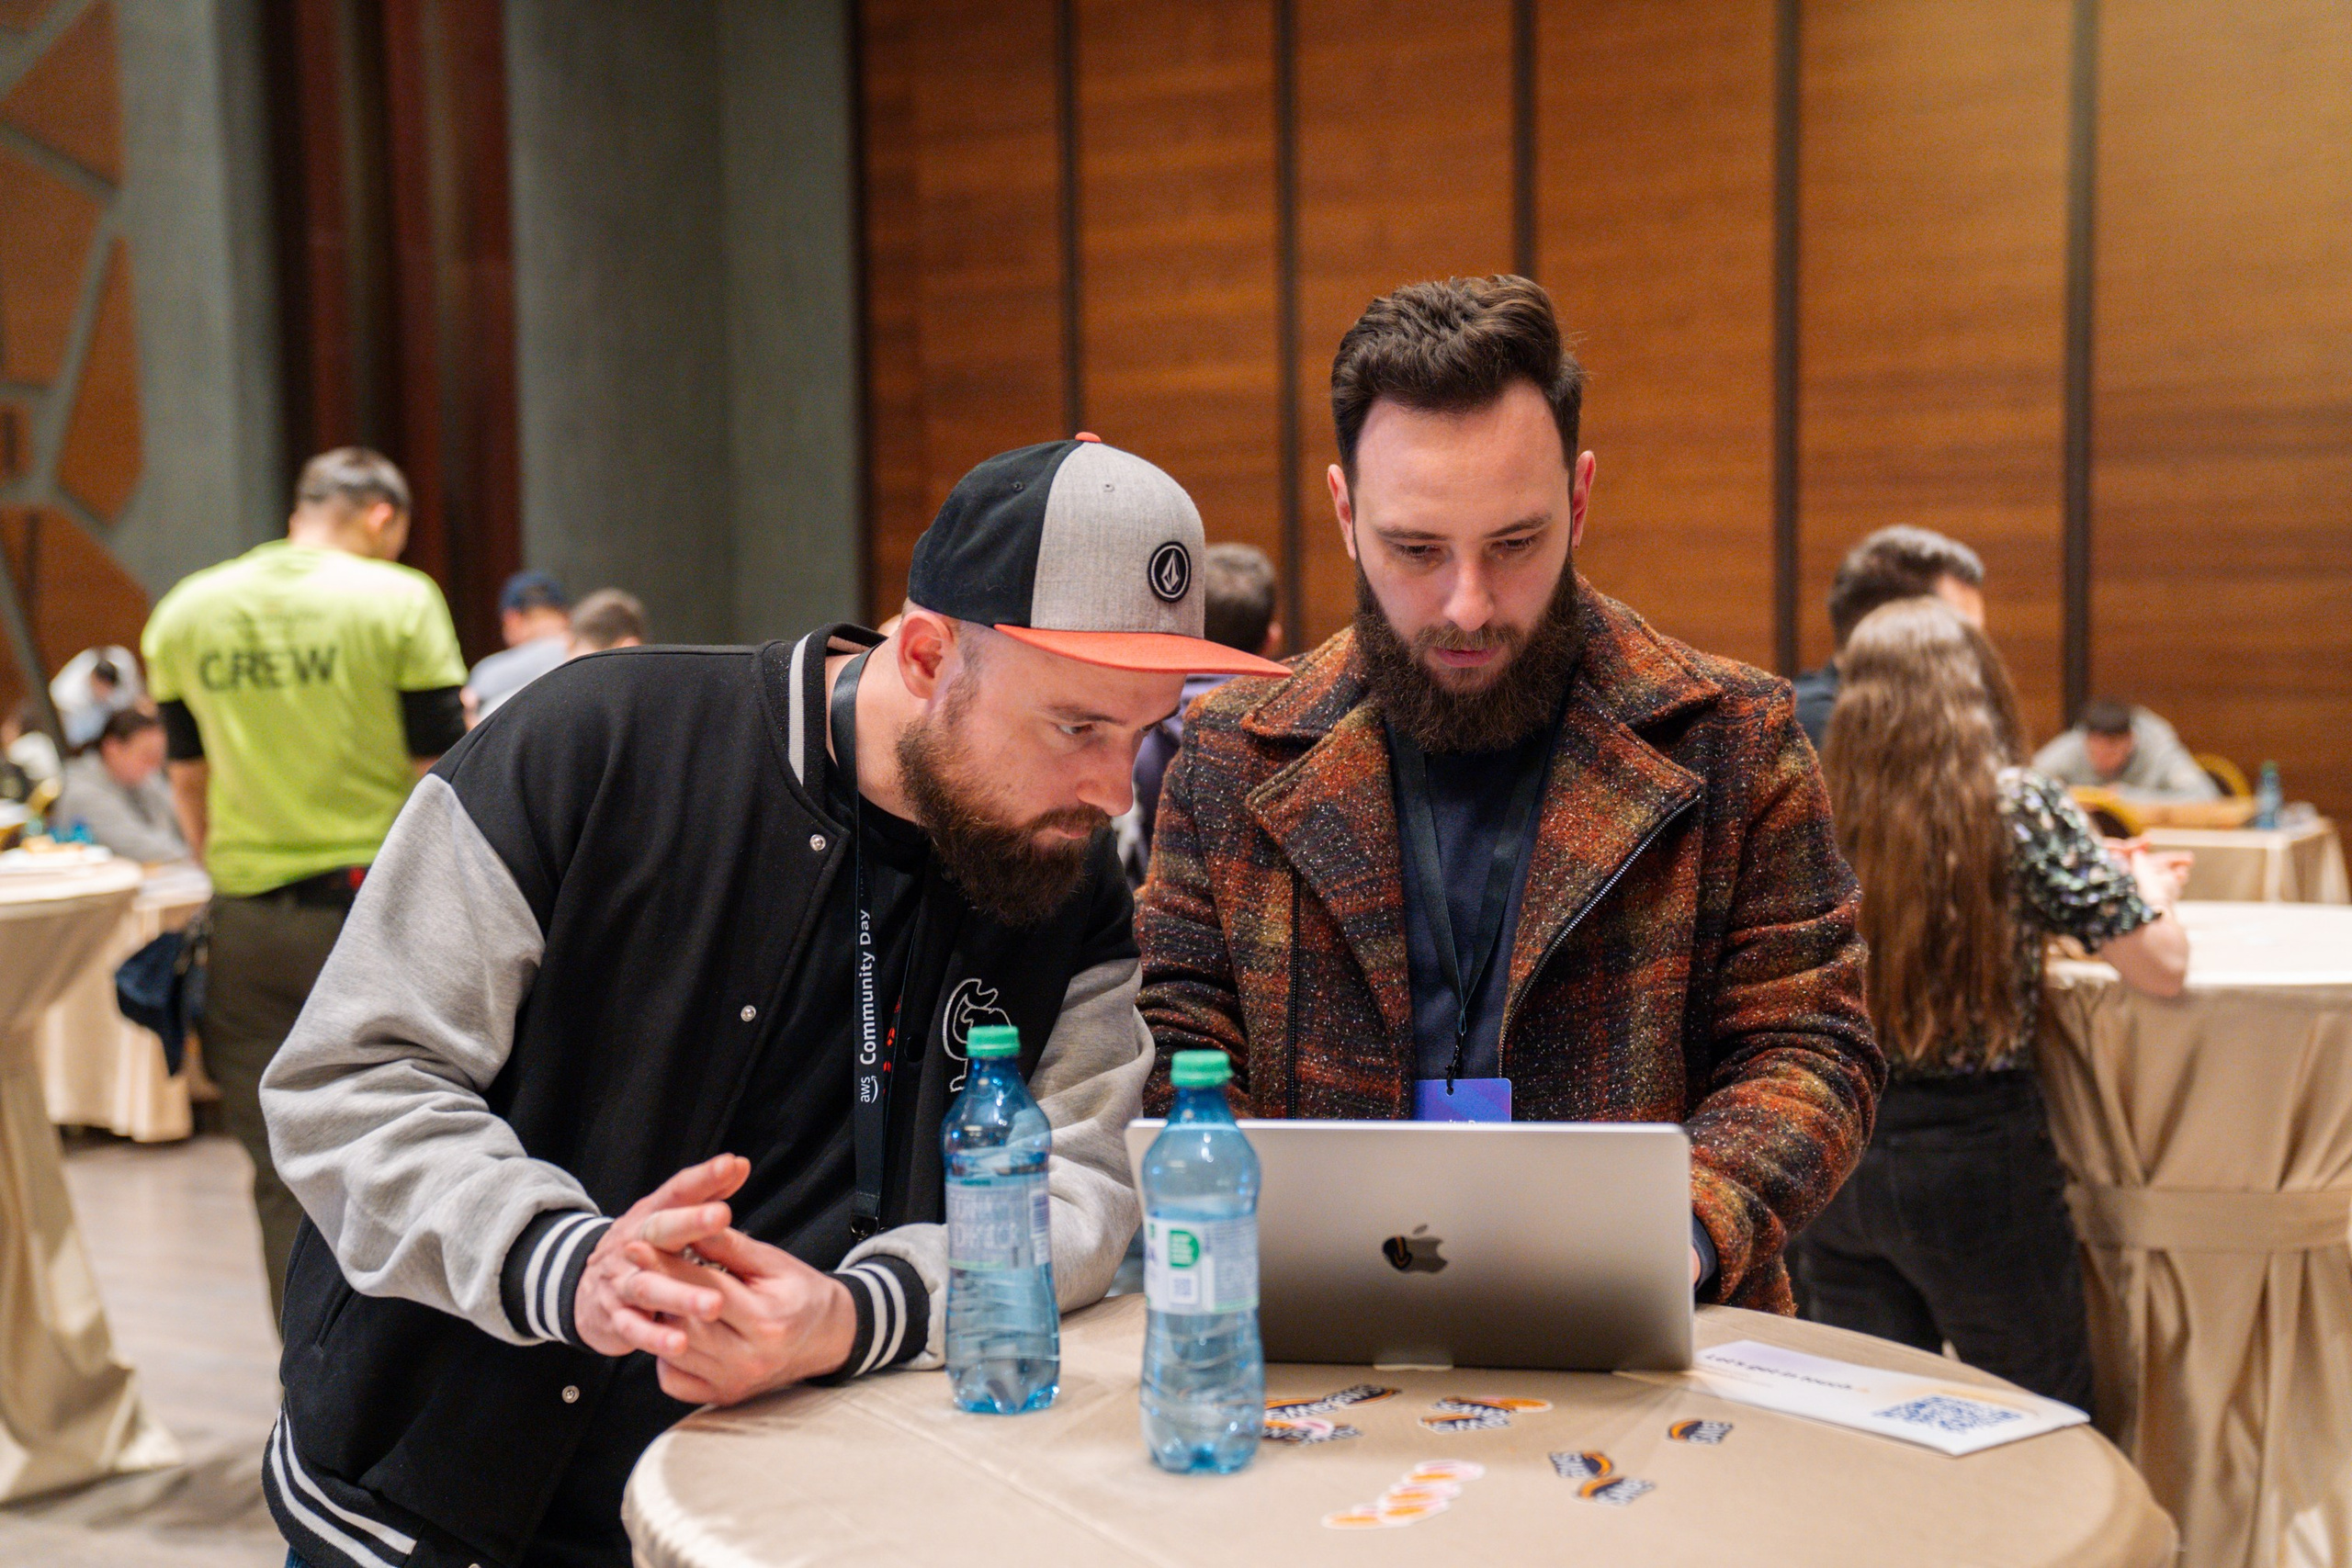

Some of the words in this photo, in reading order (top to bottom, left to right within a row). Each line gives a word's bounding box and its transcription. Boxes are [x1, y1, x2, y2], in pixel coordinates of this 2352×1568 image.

[198, 648, 336, 692] CREW
[860, 909, 871, 945] Day
[859, 952, 876, 1066] Community
[860, 1076, 872, 1103] aws
